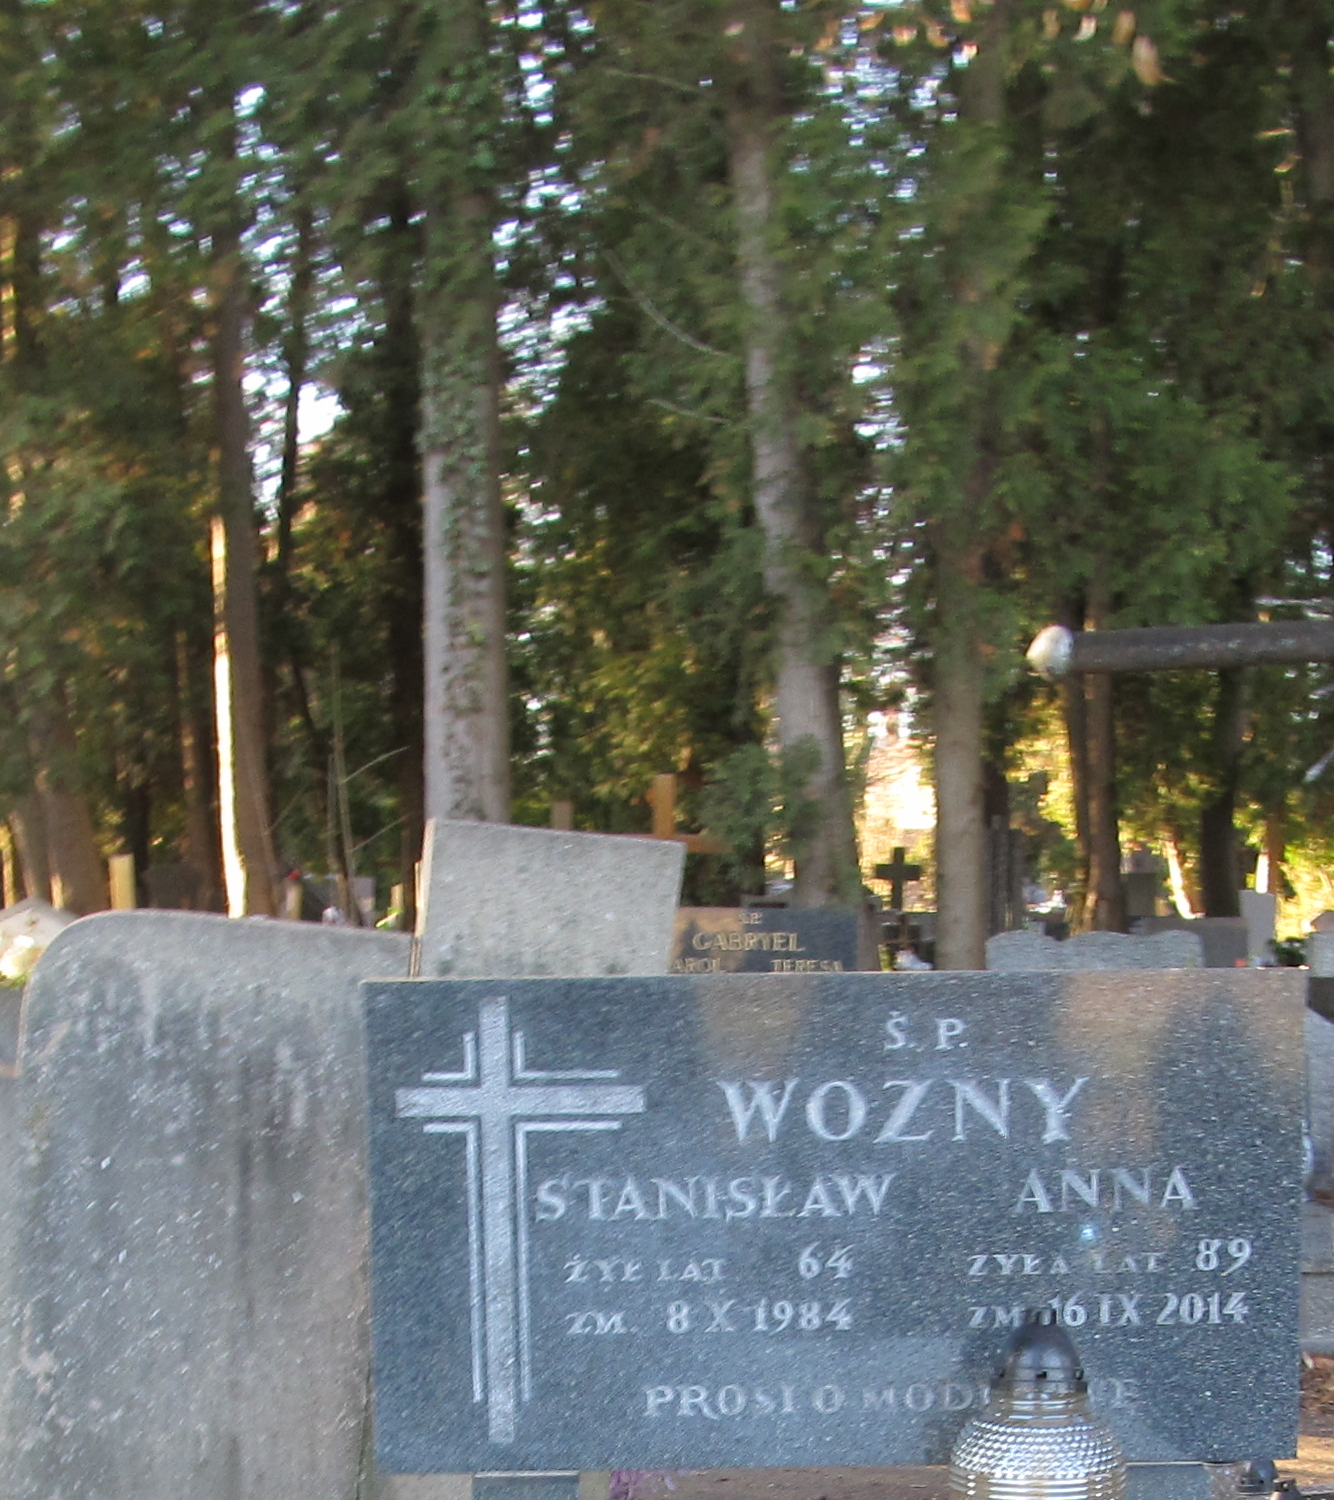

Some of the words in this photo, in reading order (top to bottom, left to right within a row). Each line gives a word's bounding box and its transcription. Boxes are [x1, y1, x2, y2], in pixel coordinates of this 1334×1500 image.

[670, 957, 725, 974] AROL
[533, 1172, 899, 1224] STANISŁAW
[1016, 1166, 1199, 1214] ANNA
[656, 1257, 727, 1284] LAT
[797, 1240, 856, 1281] 64
[1089, 1251, 1169, 1275] LAT
[1194, 1237, 1254, 1278] 89
[666, 1299, 691, 1335] 8
[703, 1299, 738, 1333] X
[752, 1296, 855, 1335] 1984
[1095, 1293, 1145, 1327] IX
[1154, 1291, 1251, 1326] 2014
[814, 1383, 845, 1414] O
